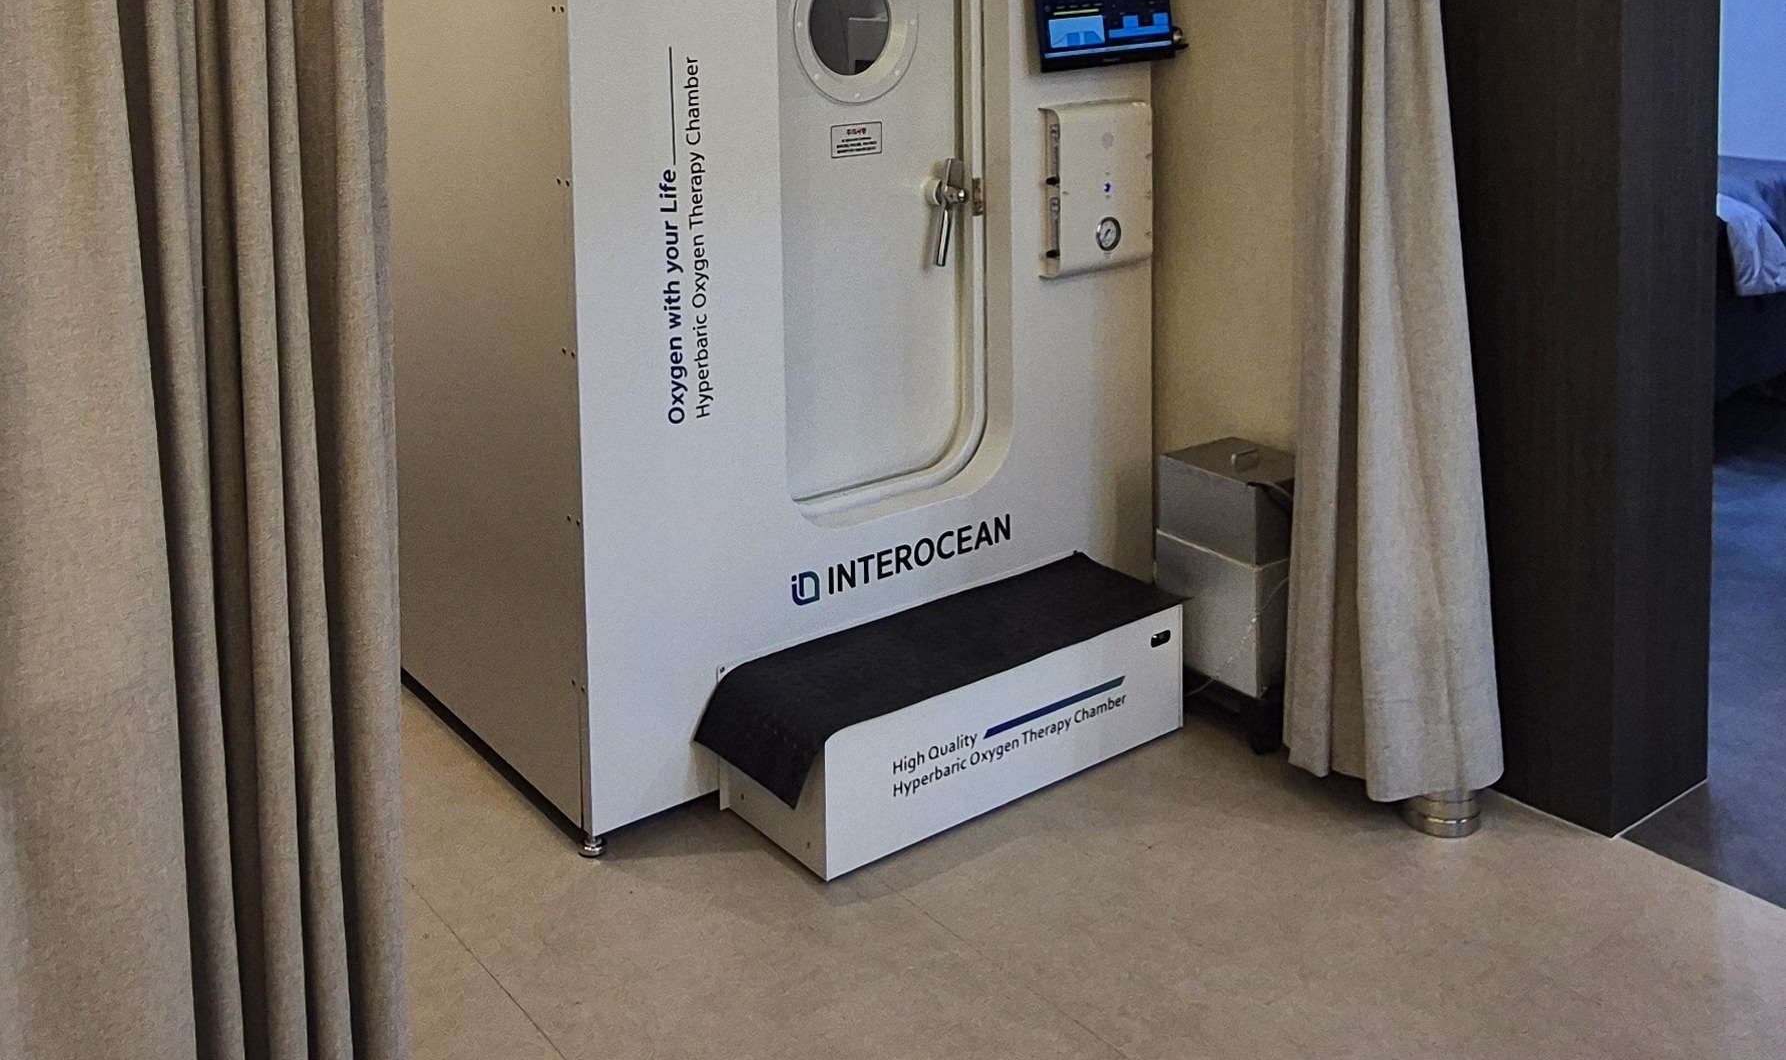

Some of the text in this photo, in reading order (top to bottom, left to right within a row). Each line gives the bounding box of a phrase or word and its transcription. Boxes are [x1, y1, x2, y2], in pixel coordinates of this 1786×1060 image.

[684, 56, 714, 419] Hyperbaric Oxygen Therapy Chamber
[659, 169, 688, 425] Oxygen with your Life
[828, 513, 1011, 595] INTEROCEAN
[892, 694, 1127, 797] Hyperbaric Oxygen Therapy Chamber
[892, 733, 978, 775] High Quality
